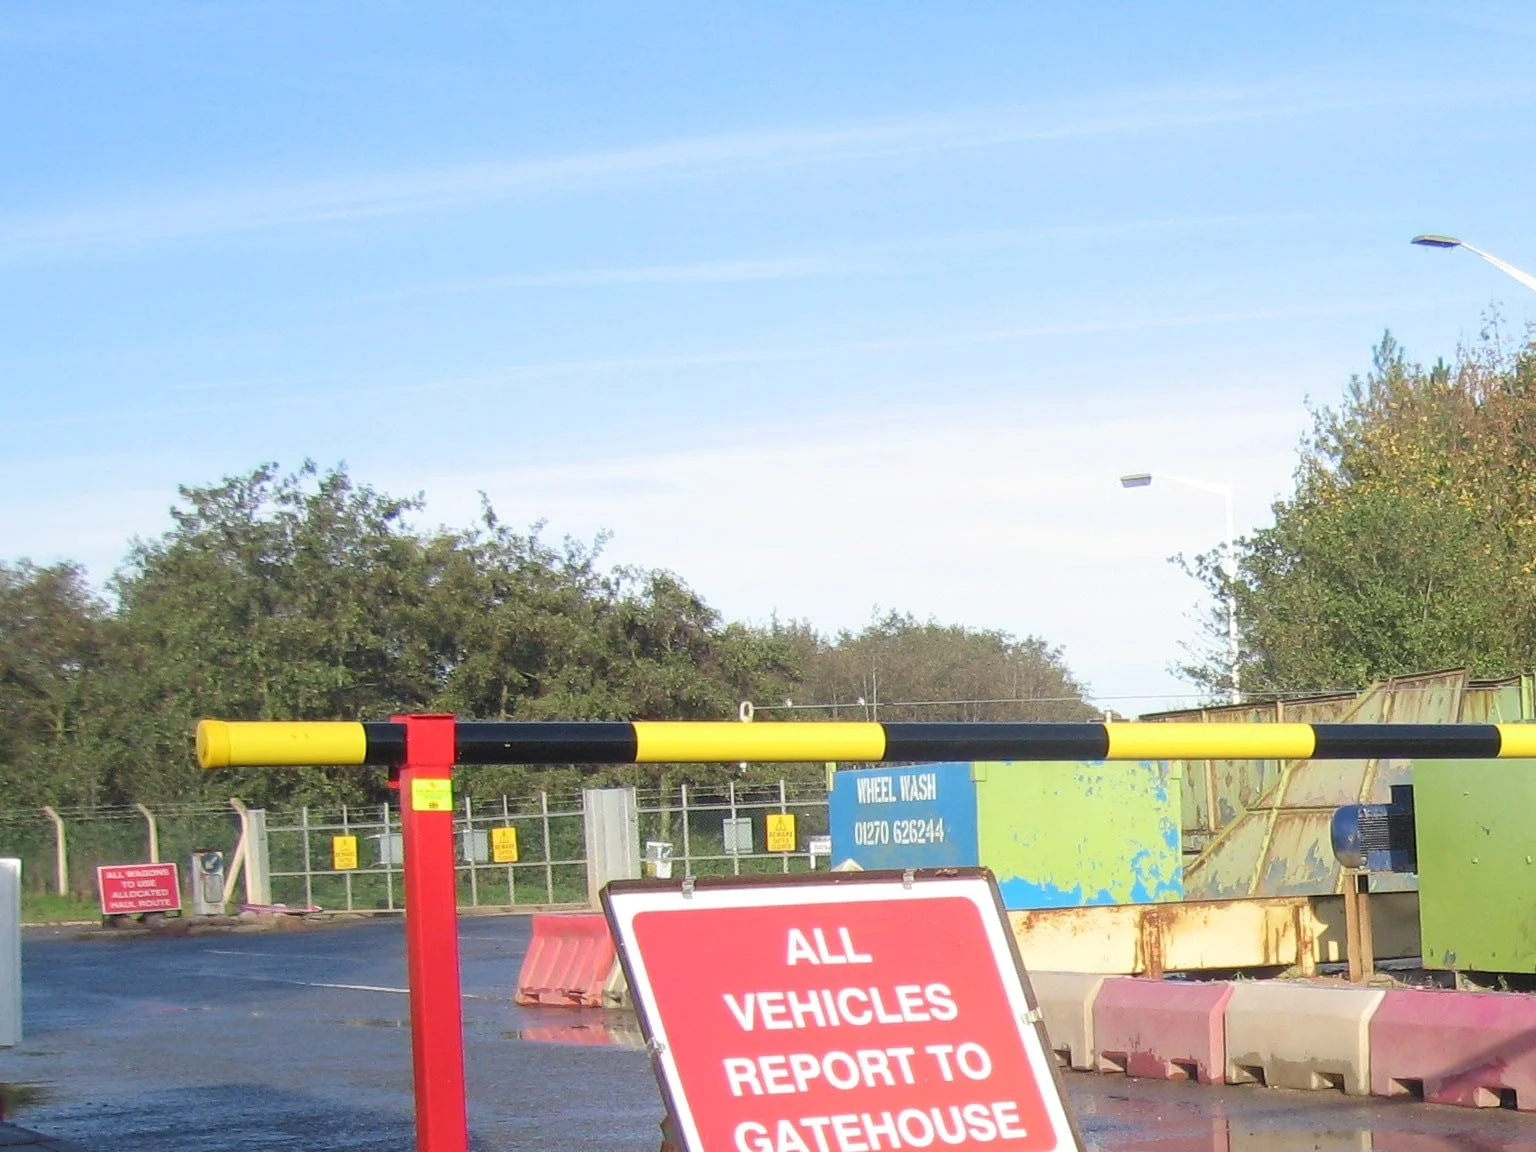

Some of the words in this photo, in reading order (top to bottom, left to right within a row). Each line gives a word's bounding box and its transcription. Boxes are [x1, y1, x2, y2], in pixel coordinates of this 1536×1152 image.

[857, 776, 896, 804] WHEEL
[900, 773, 936, 801] WASH
[855, 820, 889, 845] 01270
[893, 817, 944, 844] 626244
[106, 871, 125, 879] ALL
[125, 868, 170, 878] WAGONS
[121, 880, 136, 888] TO
[136, 879, 157, 887] USE
[110, 901, 137, 909] HAUL
[138, 899, 172, 907] ROUTE
[111, 888, 169, 899] ALLOCATED
[785, 927, 873, 967] ALL
[723, 983, 959, 1032] VEHICLES
[723, 1046, 917, 1097] REPORT
[925, 1042, 992, 1082] TO
